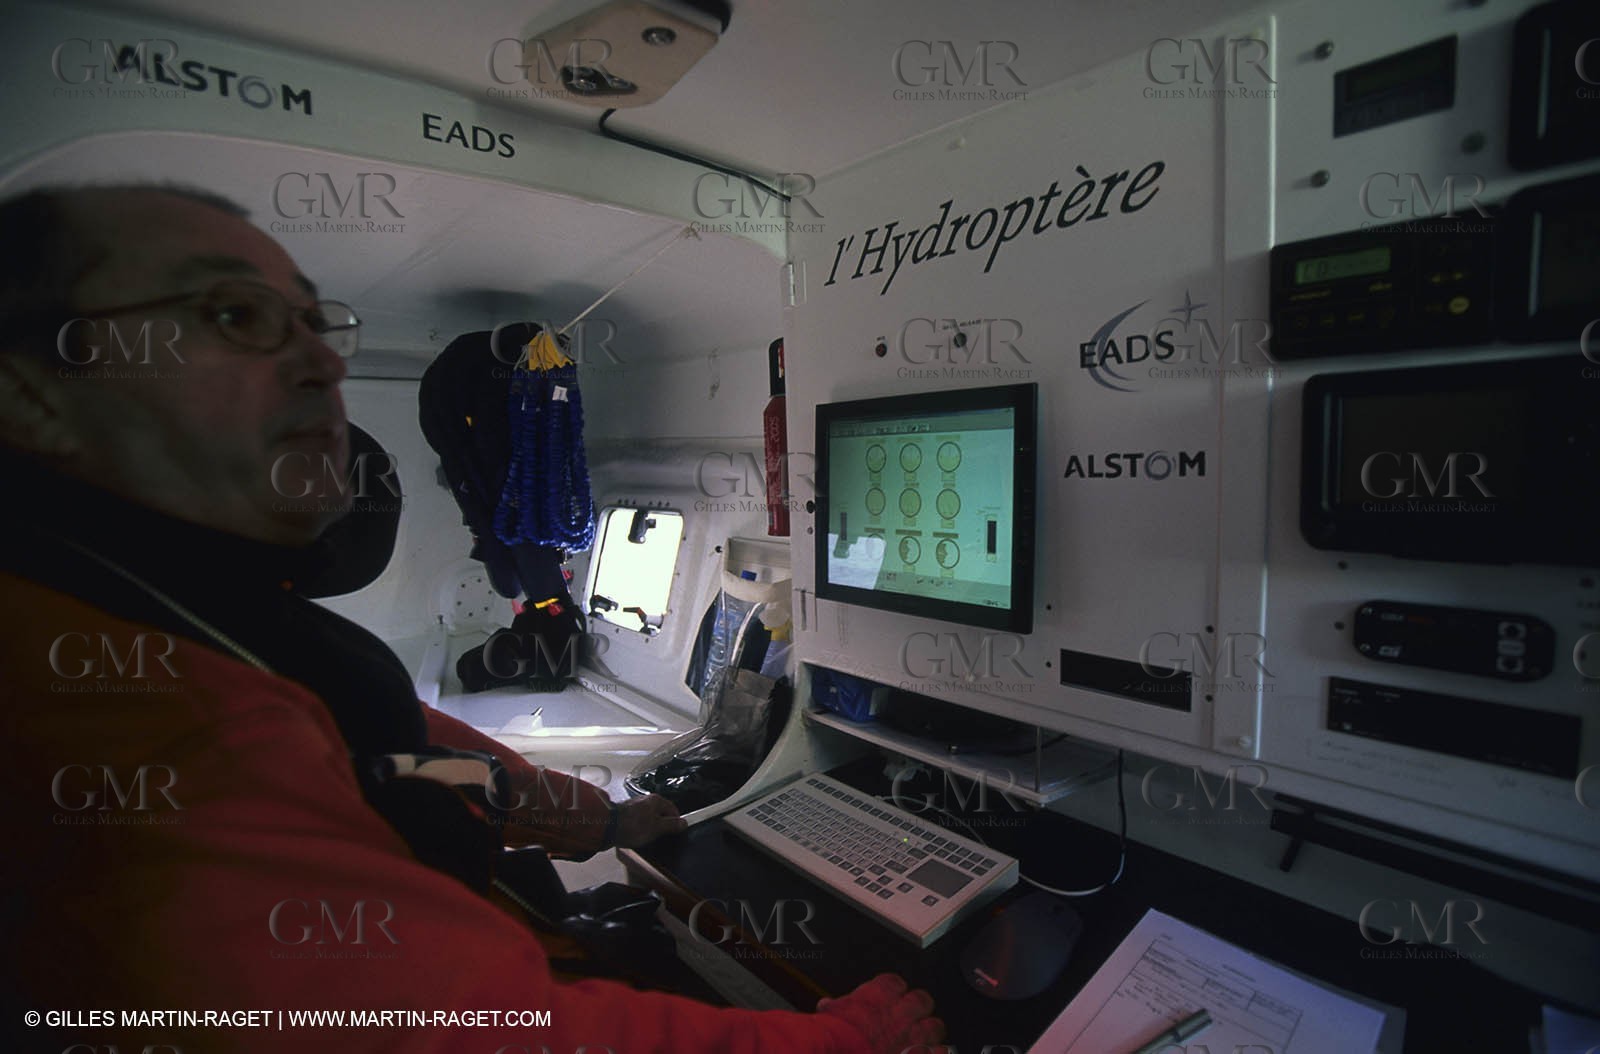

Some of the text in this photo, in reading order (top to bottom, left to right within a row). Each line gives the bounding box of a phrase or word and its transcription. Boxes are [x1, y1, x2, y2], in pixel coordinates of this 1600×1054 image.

[113, 45, 313, 115] ALSTOM
[422, 112, 515, 158] EADS
[1080, 330, 1175, 369] EADS
[1064, 451, 1206, 481] ALSTOM
